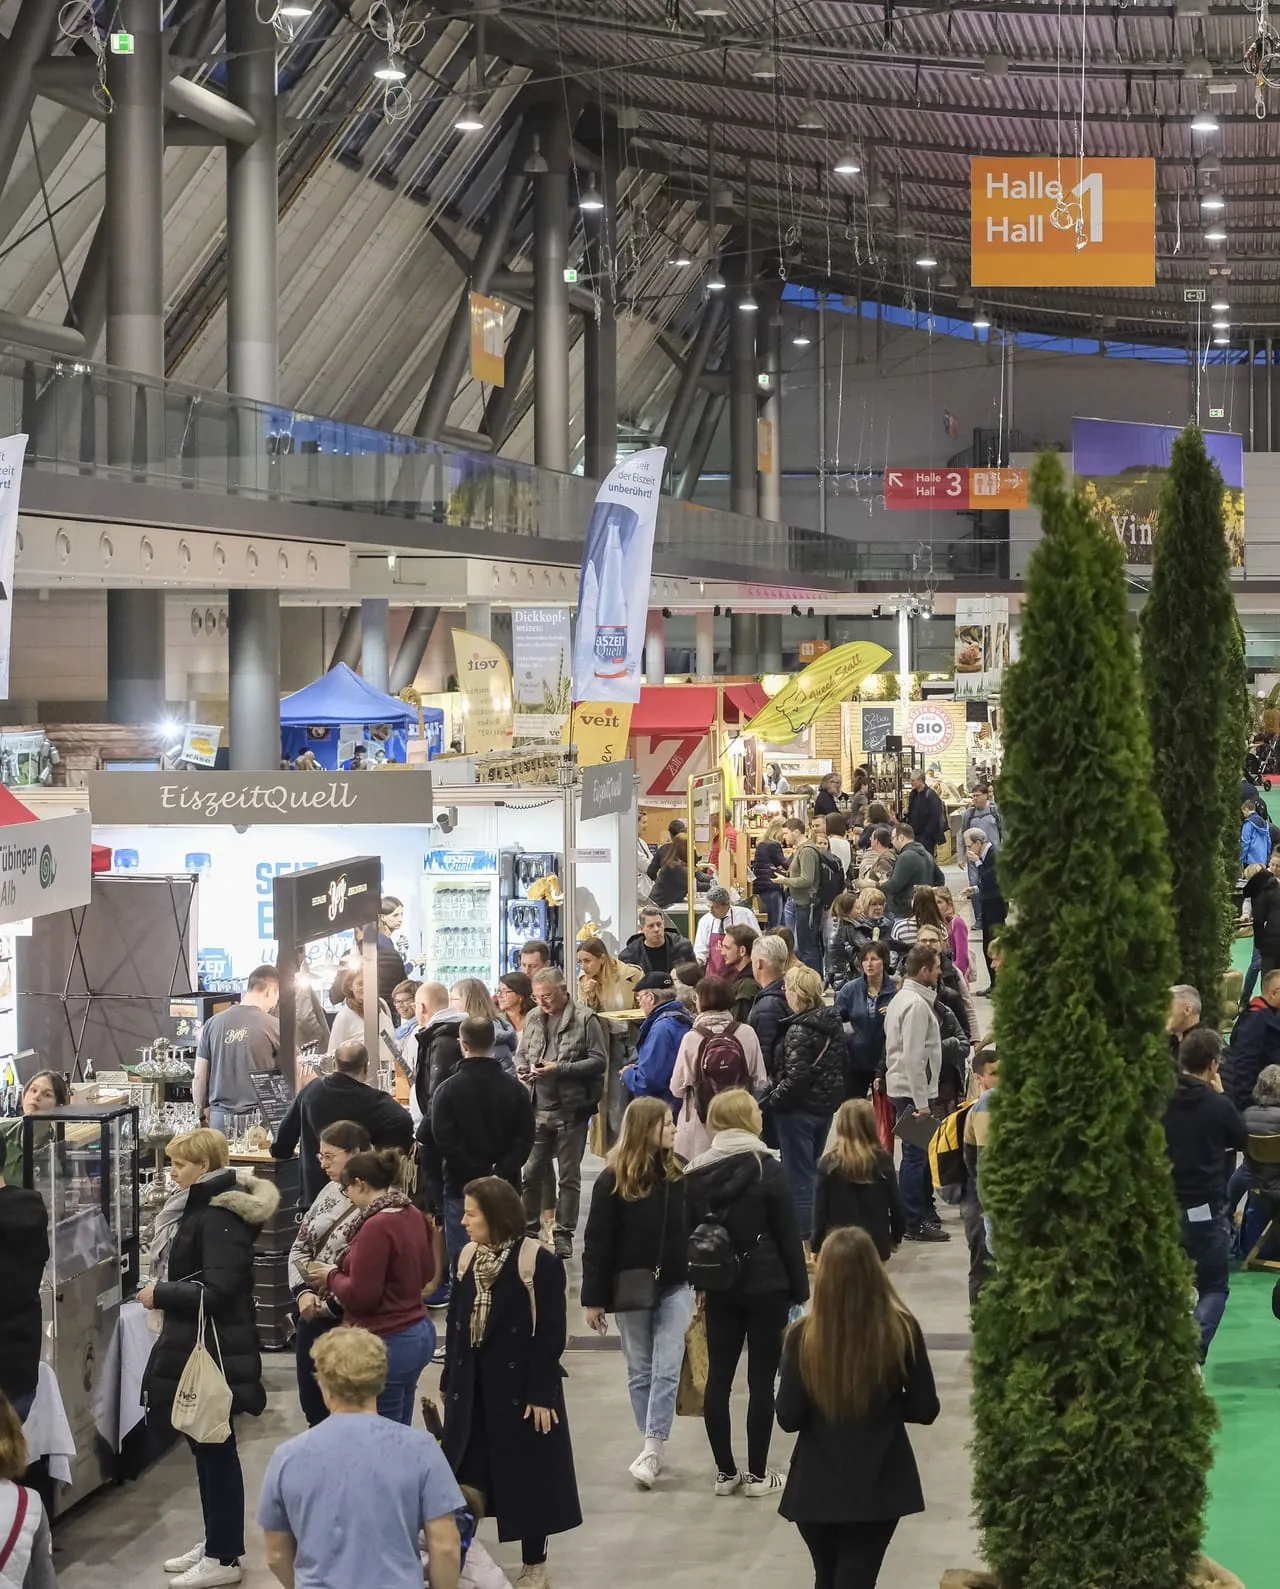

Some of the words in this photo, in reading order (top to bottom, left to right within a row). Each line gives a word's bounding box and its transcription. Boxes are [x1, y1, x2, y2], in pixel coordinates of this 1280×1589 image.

[986, 171, 1063, 199] Halle
[1072, 173, 1104, 243] 1
[986, 215, 1044, 242] Hall
[617, 471, 631, 479] der
[632, 474, 656, 486] Eiszeit
[916, 473, 941, 482] Halle
[946, 472, 962, 497] 3
[608, 483, 652, 498] unberührt!
[916, 487, 935, 496] Hall
[1111, 514, 1153, 545] Vin
[515, 611, 566, 626] Dickkopf-
[597, 646, 623, 659] Quell
[580, 708, 620, 728] veit
[549, 729, 561, 738] ve
[916, 723, 942, 733] BIO
[159, 783, 358, 817] EiszeitQuell
[256, 862, 318, 895] SE
